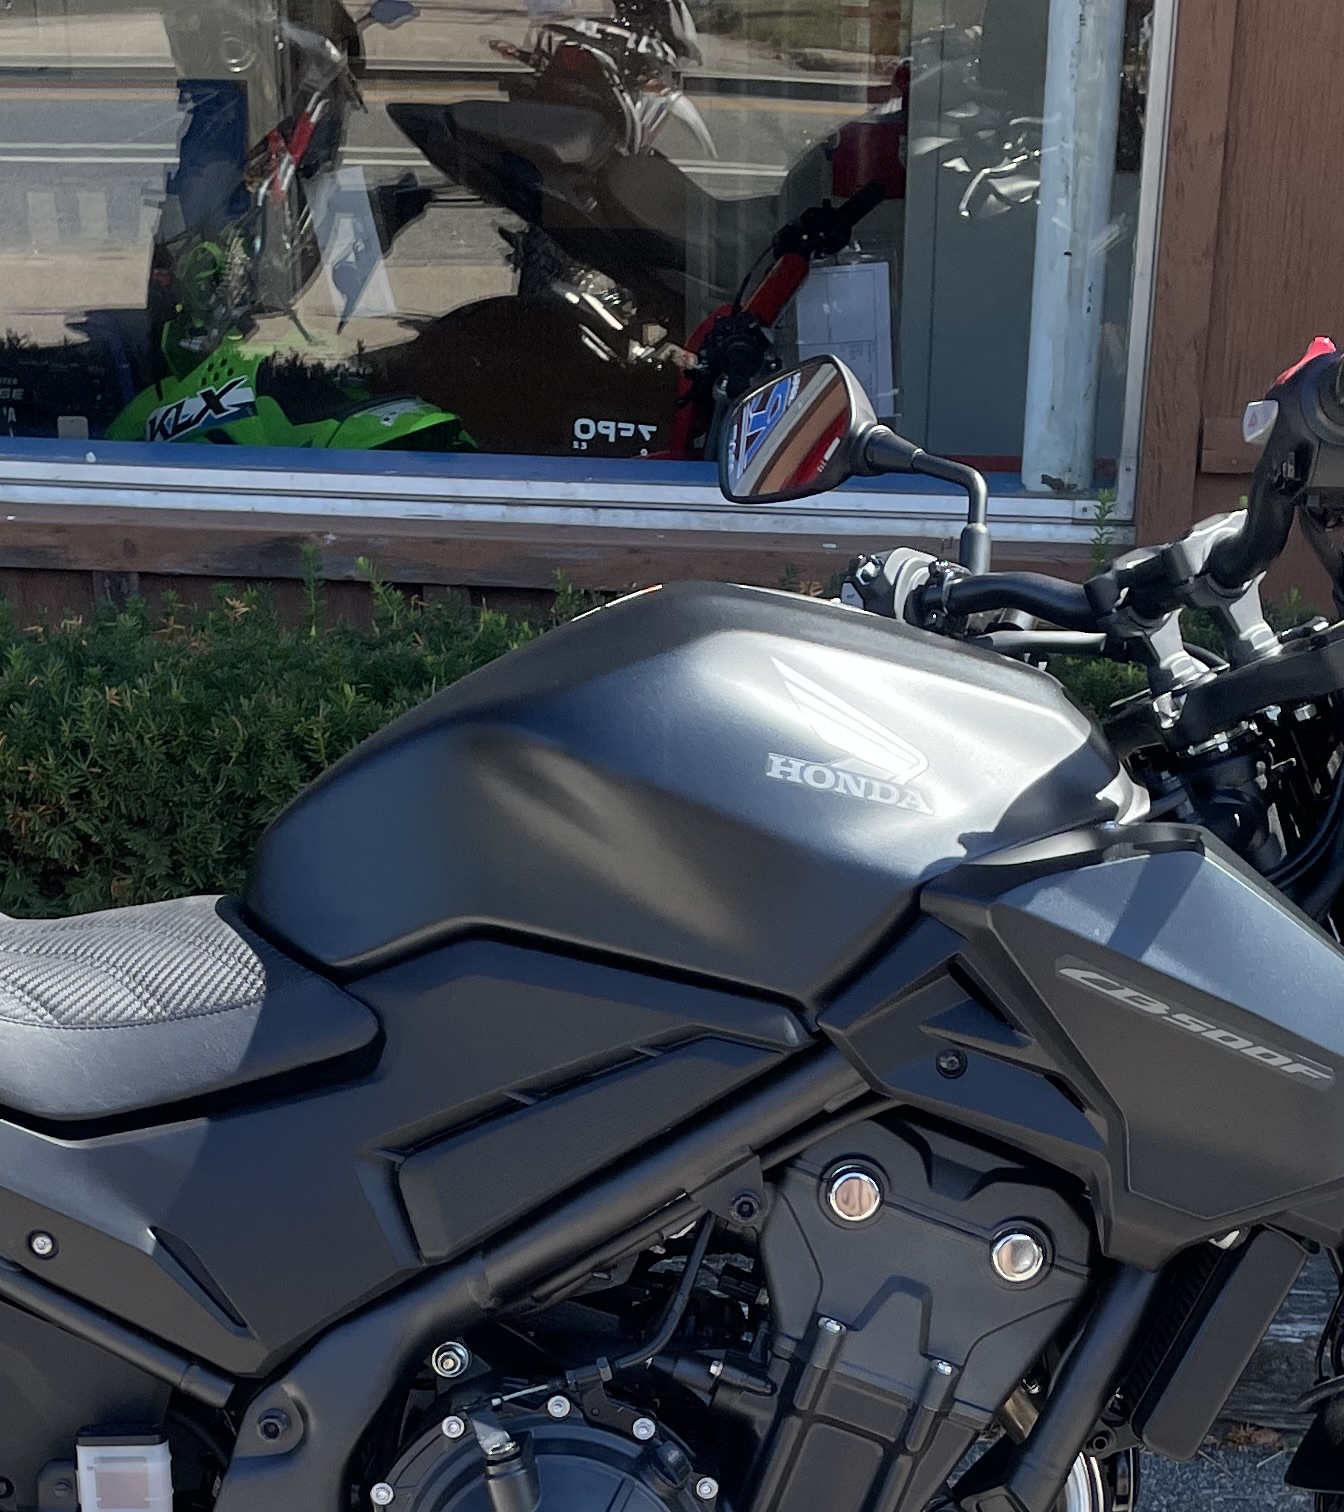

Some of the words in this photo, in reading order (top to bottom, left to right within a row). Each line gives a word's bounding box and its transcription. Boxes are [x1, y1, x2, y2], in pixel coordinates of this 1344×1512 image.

[149, 375, 249, 441] KLX
[766, 753, 934, 815] HONDA
[1059, 967, 1334, 1079] CB500F
